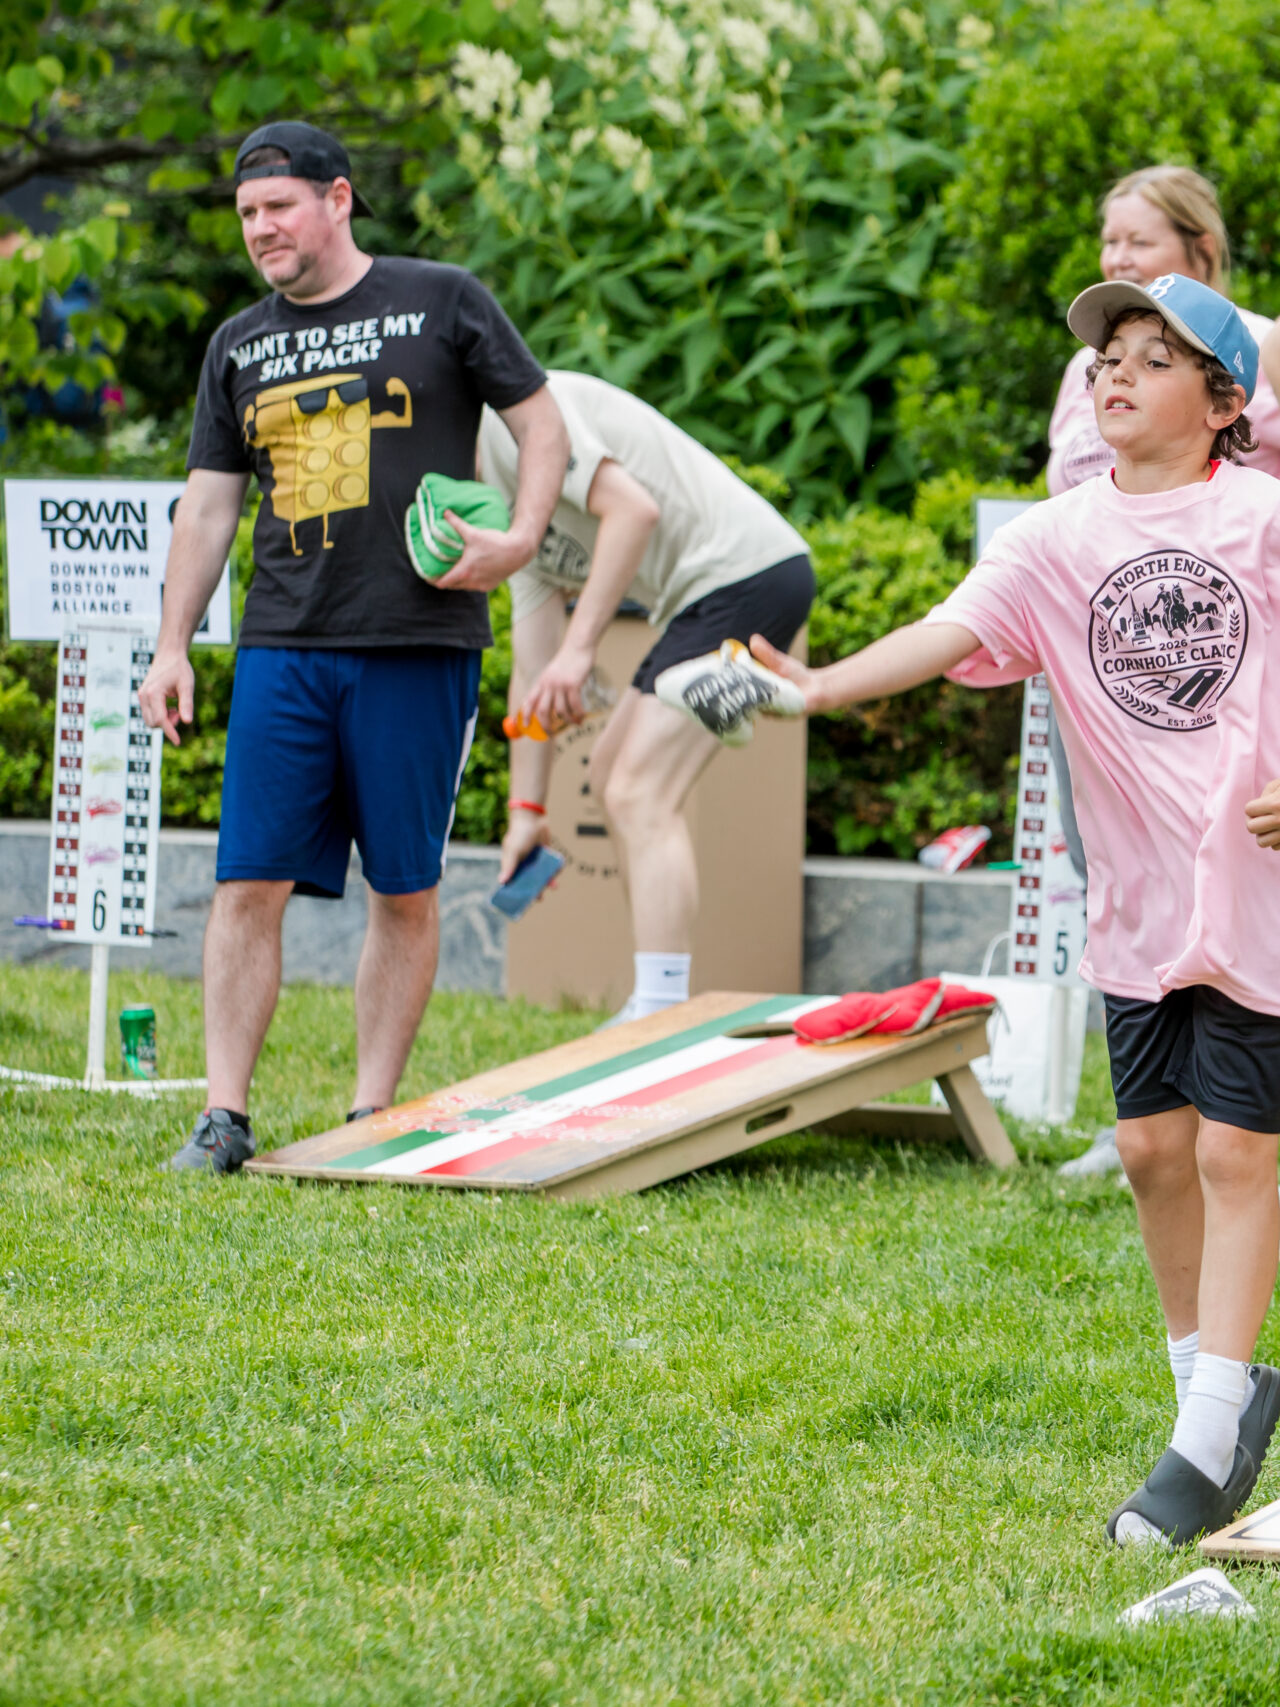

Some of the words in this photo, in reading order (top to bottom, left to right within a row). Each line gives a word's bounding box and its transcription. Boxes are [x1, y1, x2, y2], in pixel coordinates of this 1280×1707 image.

[229, 332, 290, 371] WANT
[294, 326, 328, 351] TO
[332, 318, 379, 345] SEE
[383, 312, 426, 337] MY
[259, 353, 299, 382] SIX
[302, 339, 383, 373] PACK?
[40, 499, 147, 524] DOWN
[41, 527, 147, 551] TOWN
[50, 563, 150, 578] DOWNTOWN
[1112, 558, 1169, 593] NORTH
[1174, 557, 1207, 579] END
[51, 581, 117, 595] BOSTON
[52, 600, 133, 613] ALLIANCE
[1159, 639, 1188, 651] 2026
[1103, 651, 1187, 674] CORNHOLE
[1167, 718, 1188, 727] EST.
[1191, 714, 1213, 726] 2016
[92, 889, 106, 931] 6
[1054, 931, 1069, 975] 5
